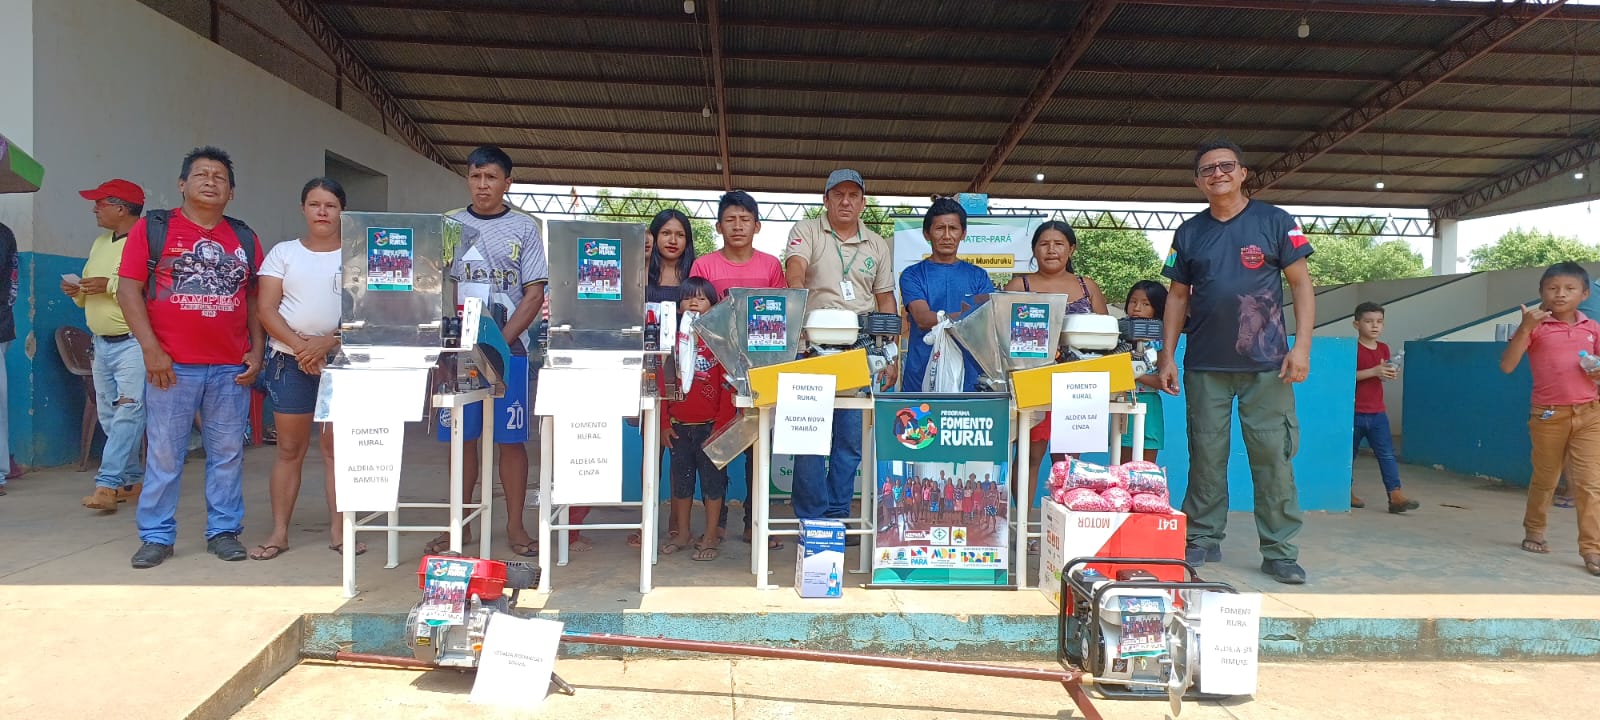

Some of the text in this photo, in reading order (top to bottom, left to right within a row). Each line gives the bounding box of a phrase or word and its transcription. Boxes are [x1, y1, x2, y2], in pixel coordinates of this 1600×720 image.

[506, 406, 524, 430] 20
[941, 416, 994, 430] FOMENTO
[352, 428, 390, 436] FOMENTO
[941, 430, 994, 446] RURAL
[1078, 517, 1110, 528] MOTOR
[960, 552, 1002, 563] BRASIL
